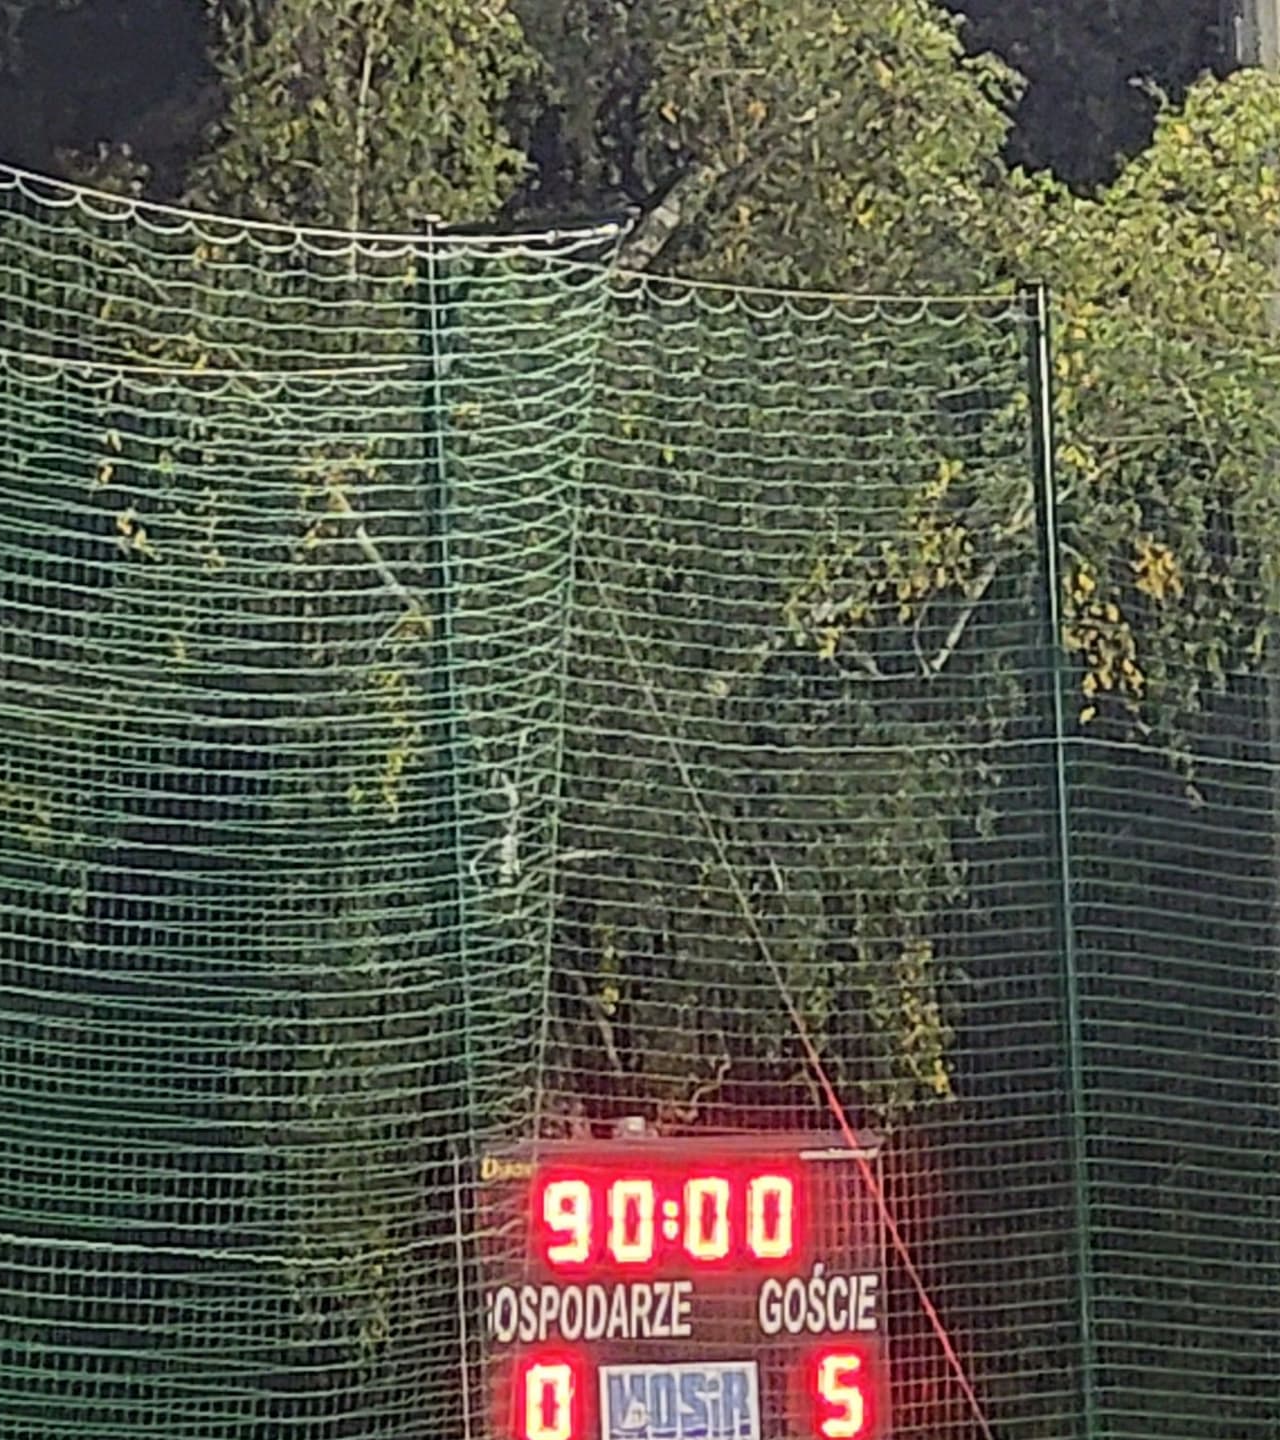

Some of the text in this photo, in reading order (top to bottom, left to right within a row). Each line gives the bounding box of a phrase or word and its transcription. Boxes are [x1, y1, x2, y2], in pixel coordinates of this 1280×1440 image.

[543, 1176, 793, 1263] 90:00
[487, 1281, 693, 1342] OSPODARZE
[759, 1263, 879, 1334] GOŚCIE
[818, 1354, 863, 1438] 5
